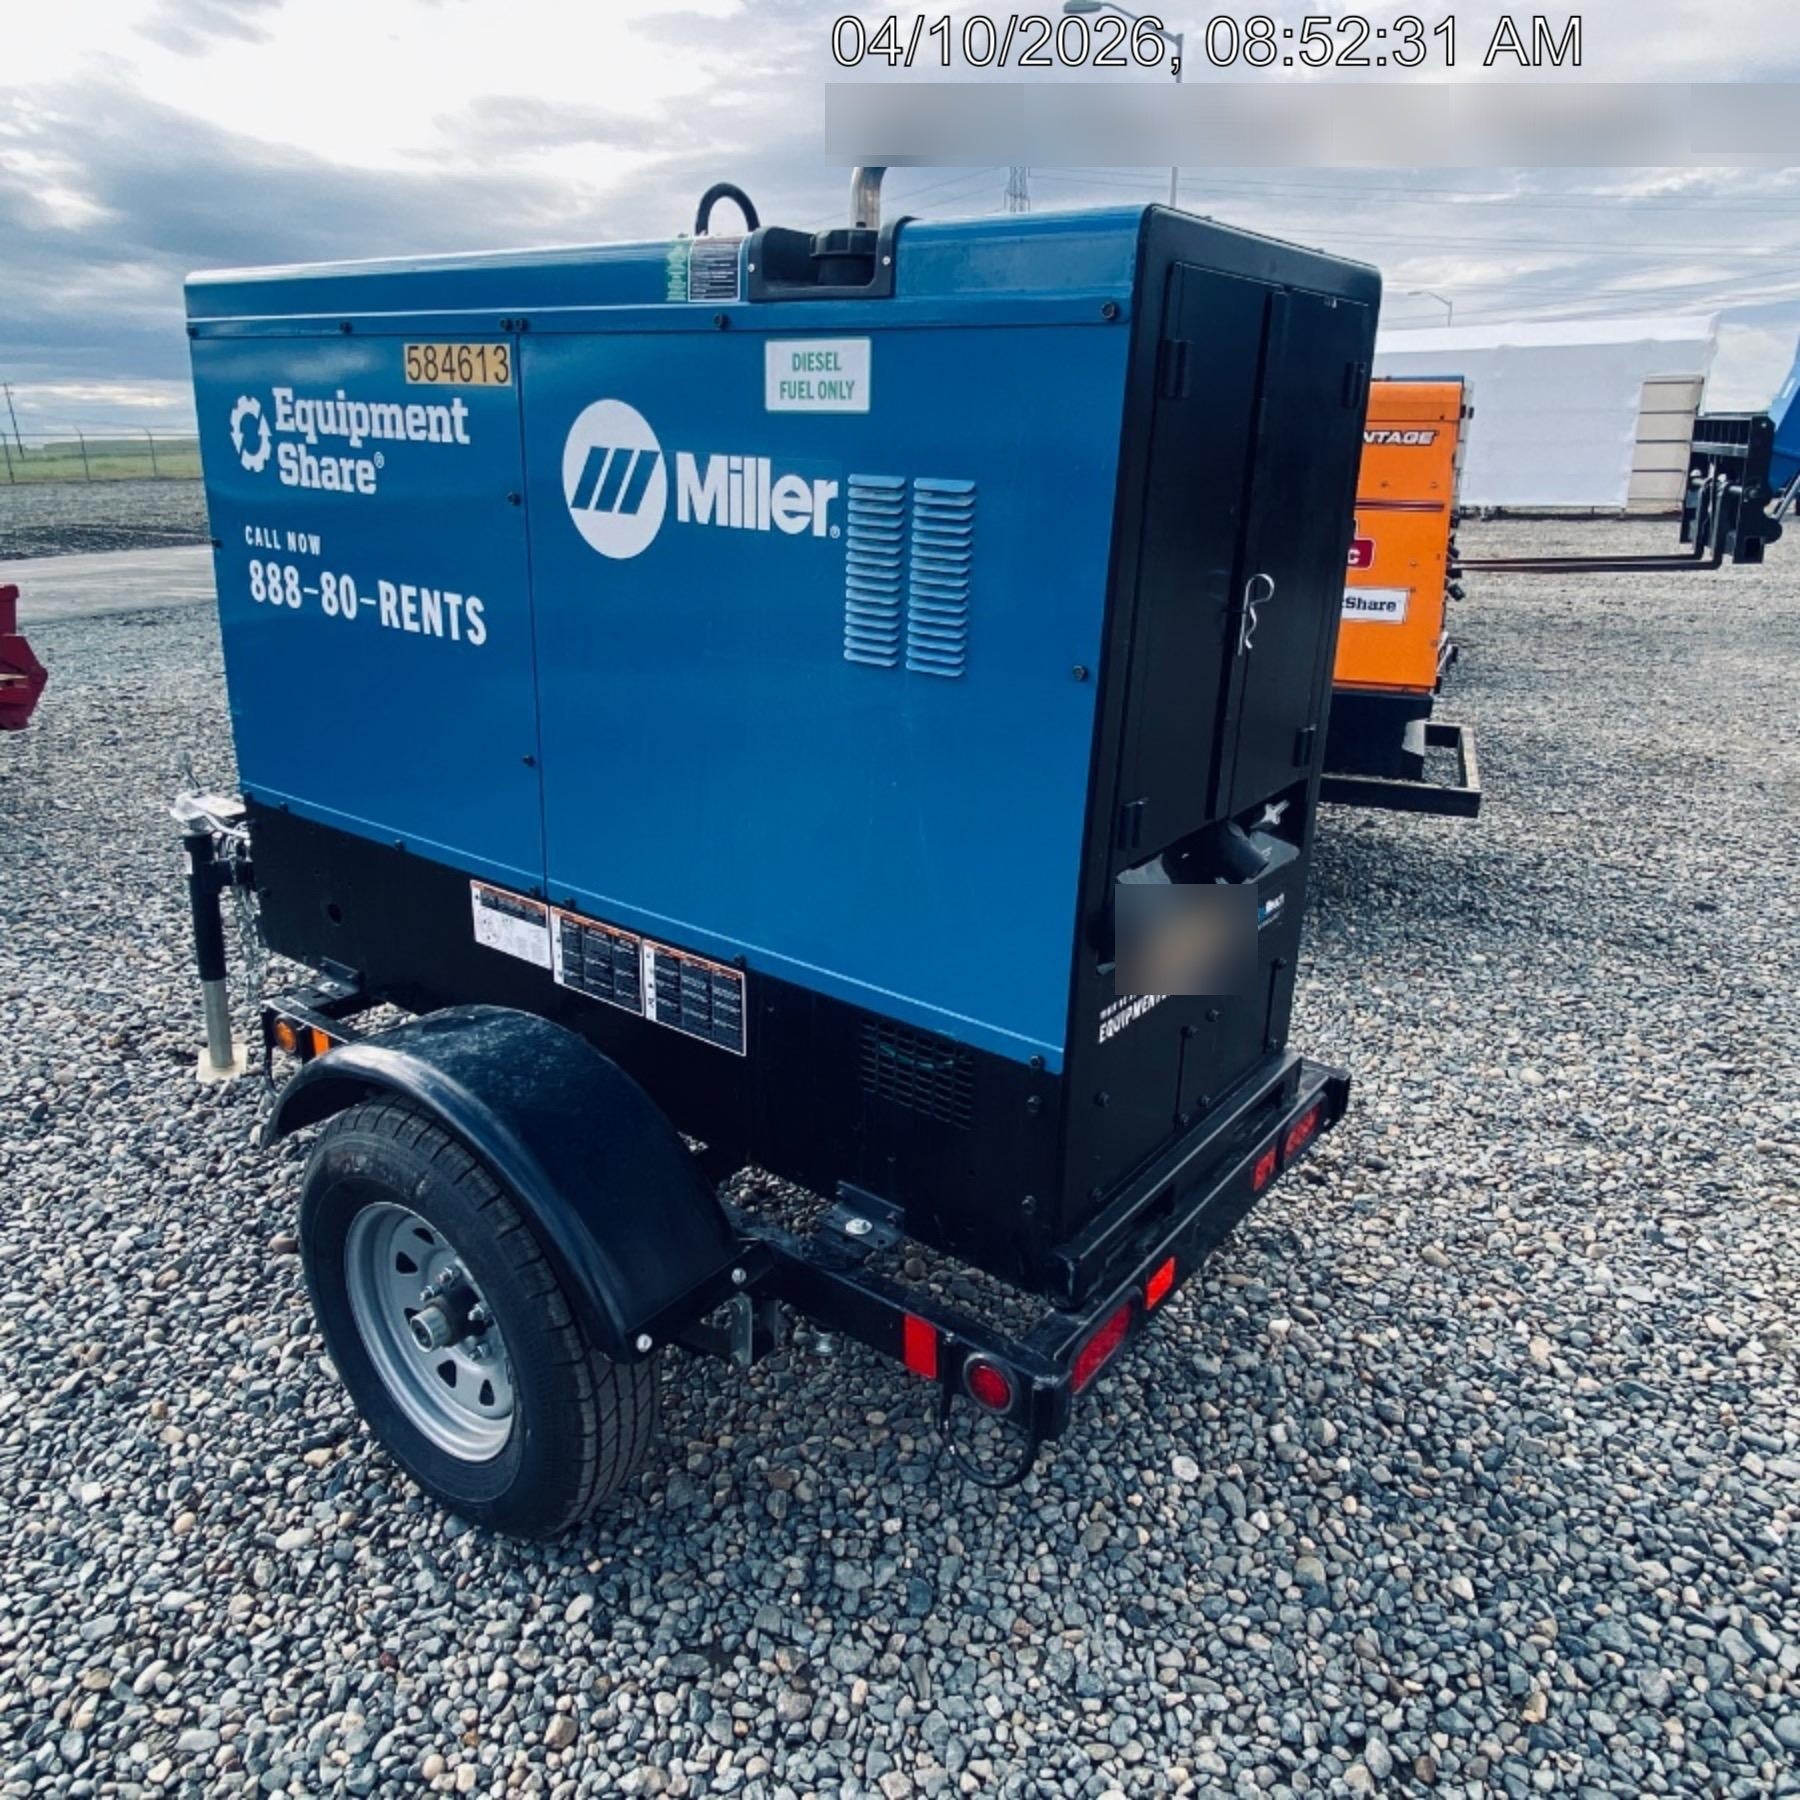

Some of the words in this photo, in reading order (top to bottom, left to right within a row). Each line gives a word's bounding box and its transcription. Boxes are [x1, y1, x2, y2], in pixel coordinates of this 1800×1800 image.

[407, 345, 509, 384] 584613
[792, 351, 842, 372] DIESEL
[779, 380, 815, 400] FUEL
[817, 380, 855, 400] ONLY
[272, 387, 471, 448] Equipment
[245, 525, 281, 550] CALL
[287, 531, 321, 556] NOW
[249, 559, 487, 645] 888-80-RENTS
[1342, 596, 1396, 613] Share
